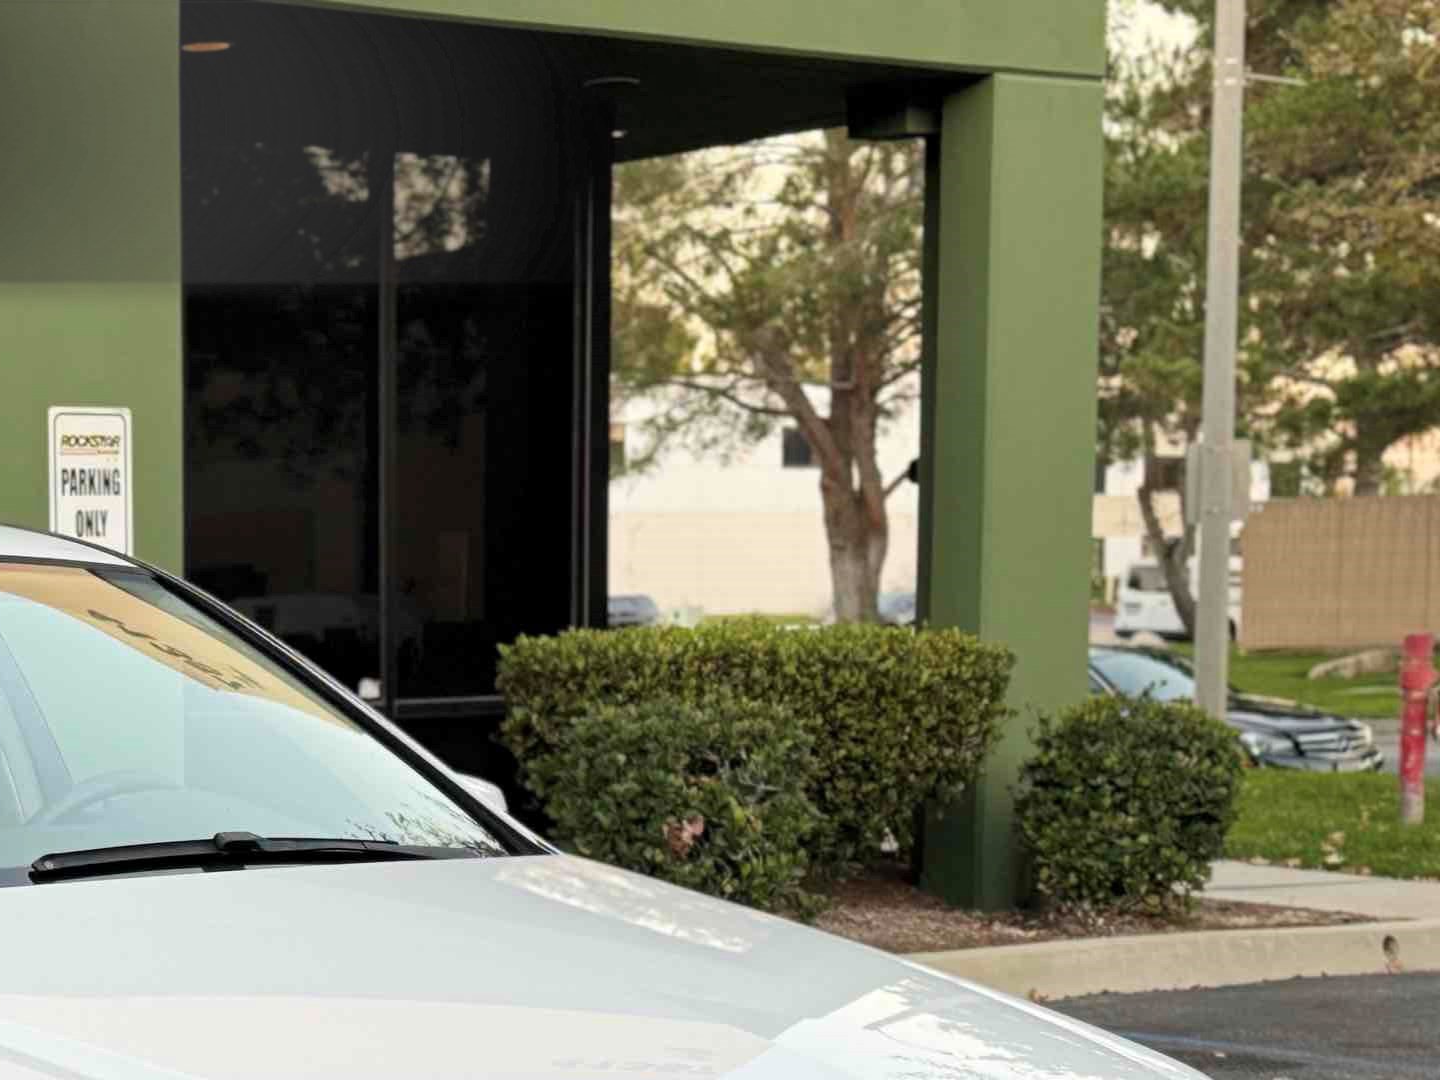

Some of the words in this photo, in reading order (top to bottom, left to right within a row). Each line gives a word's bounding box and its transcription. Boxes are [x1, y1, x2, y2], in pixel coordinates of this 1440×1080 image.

[61, 434, 121, 448] ROCKSTAR
[61, 468, 121, 496] PARKING
[76, 509, 108, 537] ONLY
